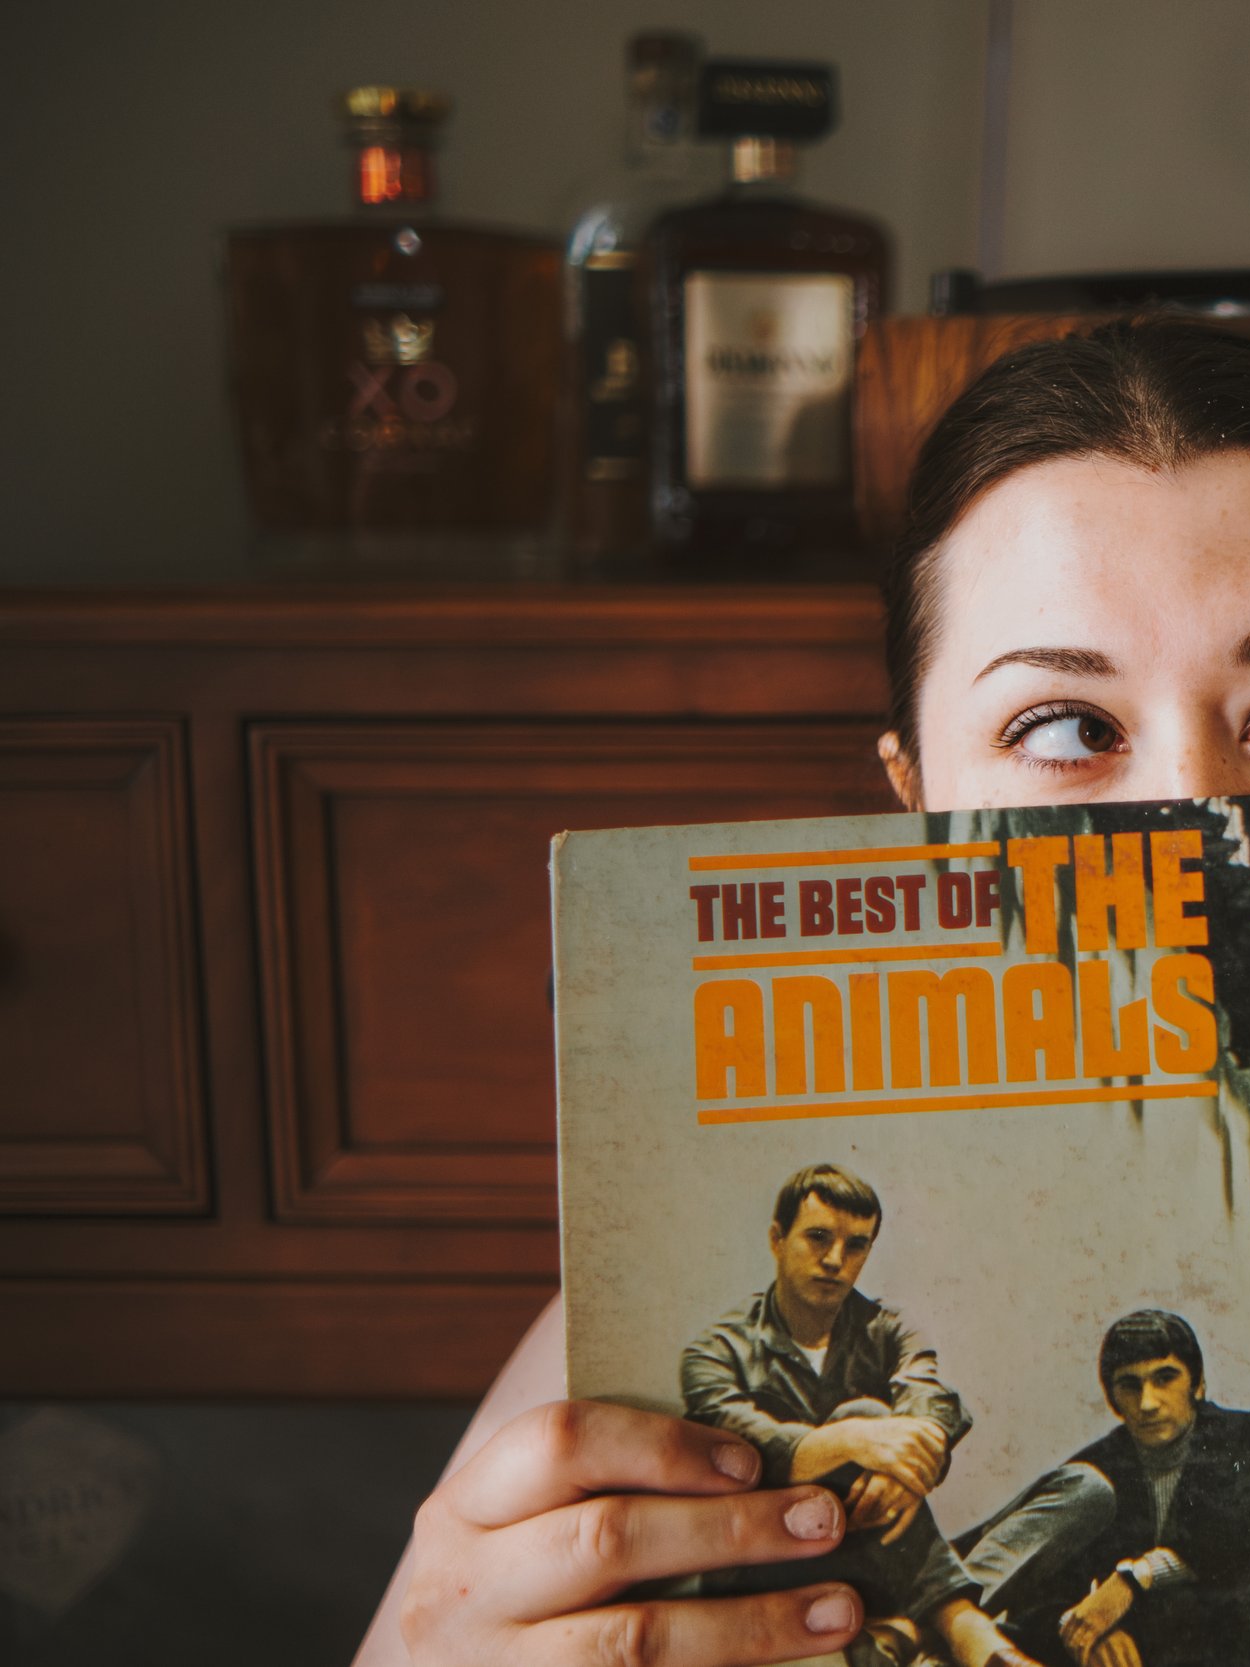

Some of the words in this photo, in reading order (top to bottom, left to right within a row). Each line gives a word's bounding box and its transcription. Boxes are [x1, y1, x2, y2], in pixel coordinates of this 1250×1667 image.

[346, 361, 457, 422] XO
[690, 884, 786, 941] THE
[800, 875, 926, 937] BEST
[937, 871, 1000, 929] OF
[1007, 830, 1208, 954] THE
[694, 954, 1218, 1099] ANIMALS
